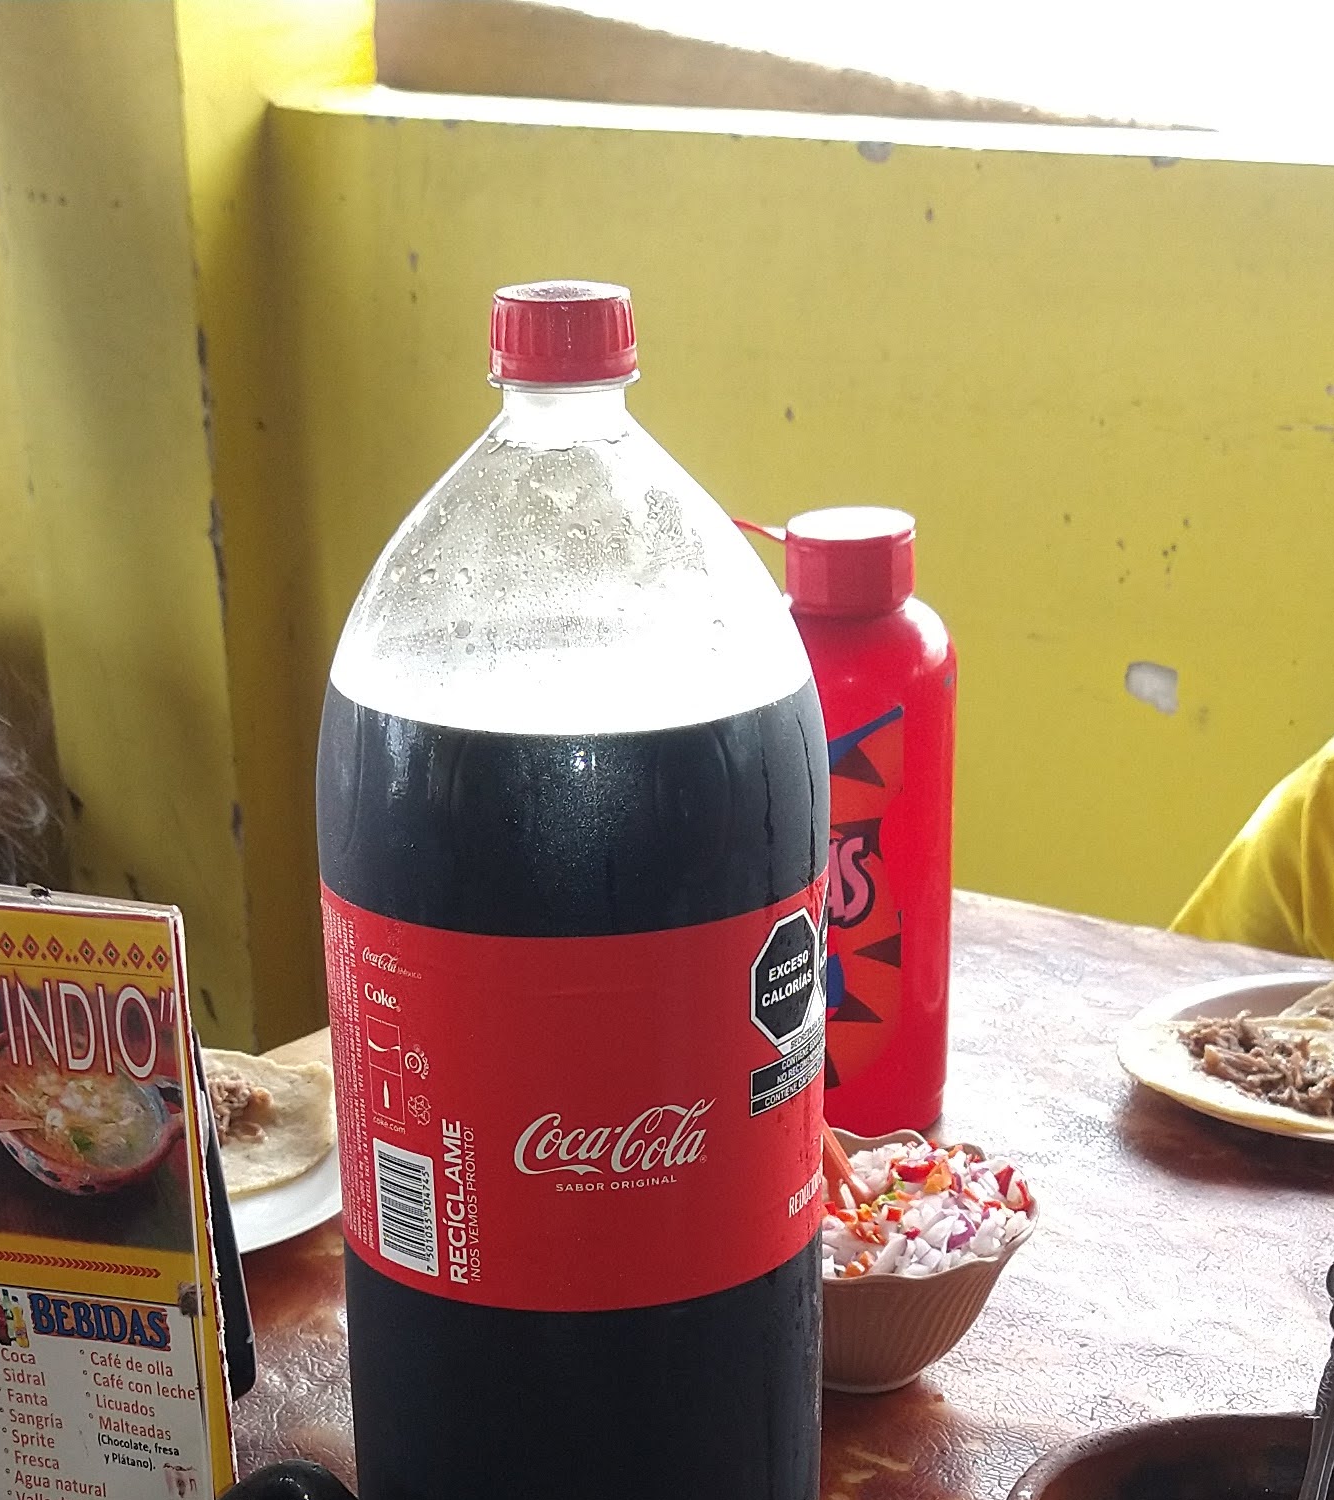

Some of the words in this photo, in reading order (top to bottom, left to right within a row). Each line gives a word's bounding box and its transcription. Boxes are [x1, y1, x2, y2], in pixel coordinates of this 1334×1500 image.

[362, 946, 398, 973] Coca-Cola
[768, 949, 809, 982] EXCESO
[364, 982, 398, 1010] Coke
[761, 968, 813, 1008] CALORÍAS
[776, 1071, 787, 1084] NO
[764, 1081, 798, 1107] CONTIENE
[373, 1116, 406, 1134] coke.com
[513, 1097, 717, 1176] Coca-Cola
[463, 1126, 476, 1192] PRONTO!
[556, 1182, 605, 1192] SABOR
[610, 1174, 678, 1191] ORIGINAL
[441, 1118, 469, 1285] RECÍCLAME
[466, 1194, 480, 1246] VEMOS
[28, 1293, 169, 1349] BEBIDAS
[1, 1347, 36, 1365] Coca
[90, 1351, 121, 1369] Café
[126, 1357, 143, 1372] de
[147, 1360, 173, 1377] olla
[2, 1368, 45, 1387] Sidral
[93, 1372, 124, 1390] Café
[128, 1381, 152, 1395] con
[157, 1382, 196, 1400] leche
[7, 1388, 48, 1407] Fanta
[96, 1394, 155, 1417] Licuados
[9, 1408, 63, 1430] Sangría
[99, 1416, 172, 1441] Malteadas
[12, 1429, 55, 1449] Sprite
[97, 1432, 152, 1454] (Chocolate,
[154, 1443, 180, 1457] fresa
[14, 1450, 60, 1470] Fresca
[103, 1453, 110, 1465] y
[14, 1470, 50, 1490] Agua
[55, 1476, 107, 1498] natural
